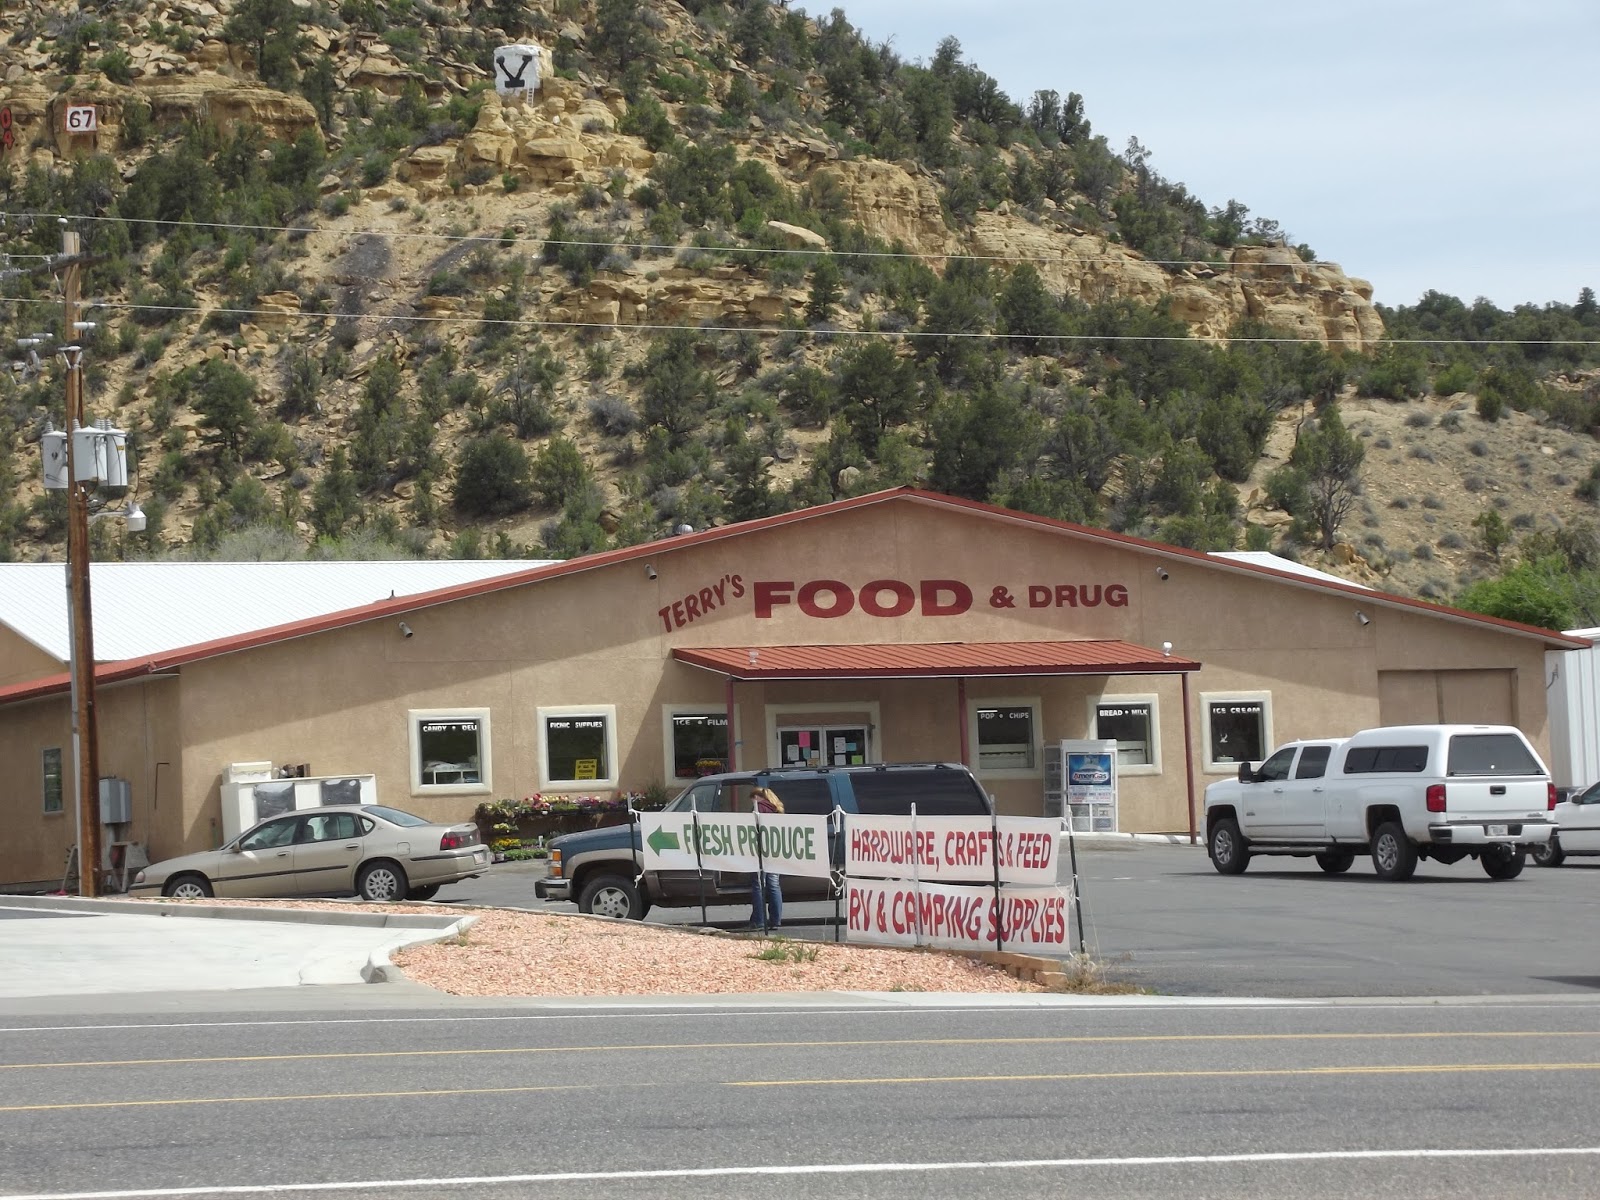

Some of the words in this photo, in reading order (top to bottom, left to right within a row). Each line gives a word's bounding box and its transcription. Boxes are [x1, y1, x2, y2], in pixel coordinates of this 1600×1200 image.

[69, 110, 93, 128] 67
[658, 574, 745, 633] TERRY'S
[754, 579, 974, 618] FOOD
[989, 585, 1016, 609] &
[1028, 584, 1129, 608] DRUG
[980, 712, 995, 720] POP
[1099, 709, 1123, 717] BREAD
[1230, 706, 1261, 714] CREAM
[574, 721, 603, 729] SUPPLIES
[683, 824, 734, 856] FRESH
[737, 825, 816, 860] PRODUCE
[851, 828, 939, 872] HARDWARE,
[1006, 833, 1014, 867] &
[1016, 833, 1052, 869] FEED
[849, 888, 873, 931] RV
[876, 891, 888, 933] &
[892, 891, 983, 940] CAMPING
[986, 897, 1065, 944] SUPPLIES
